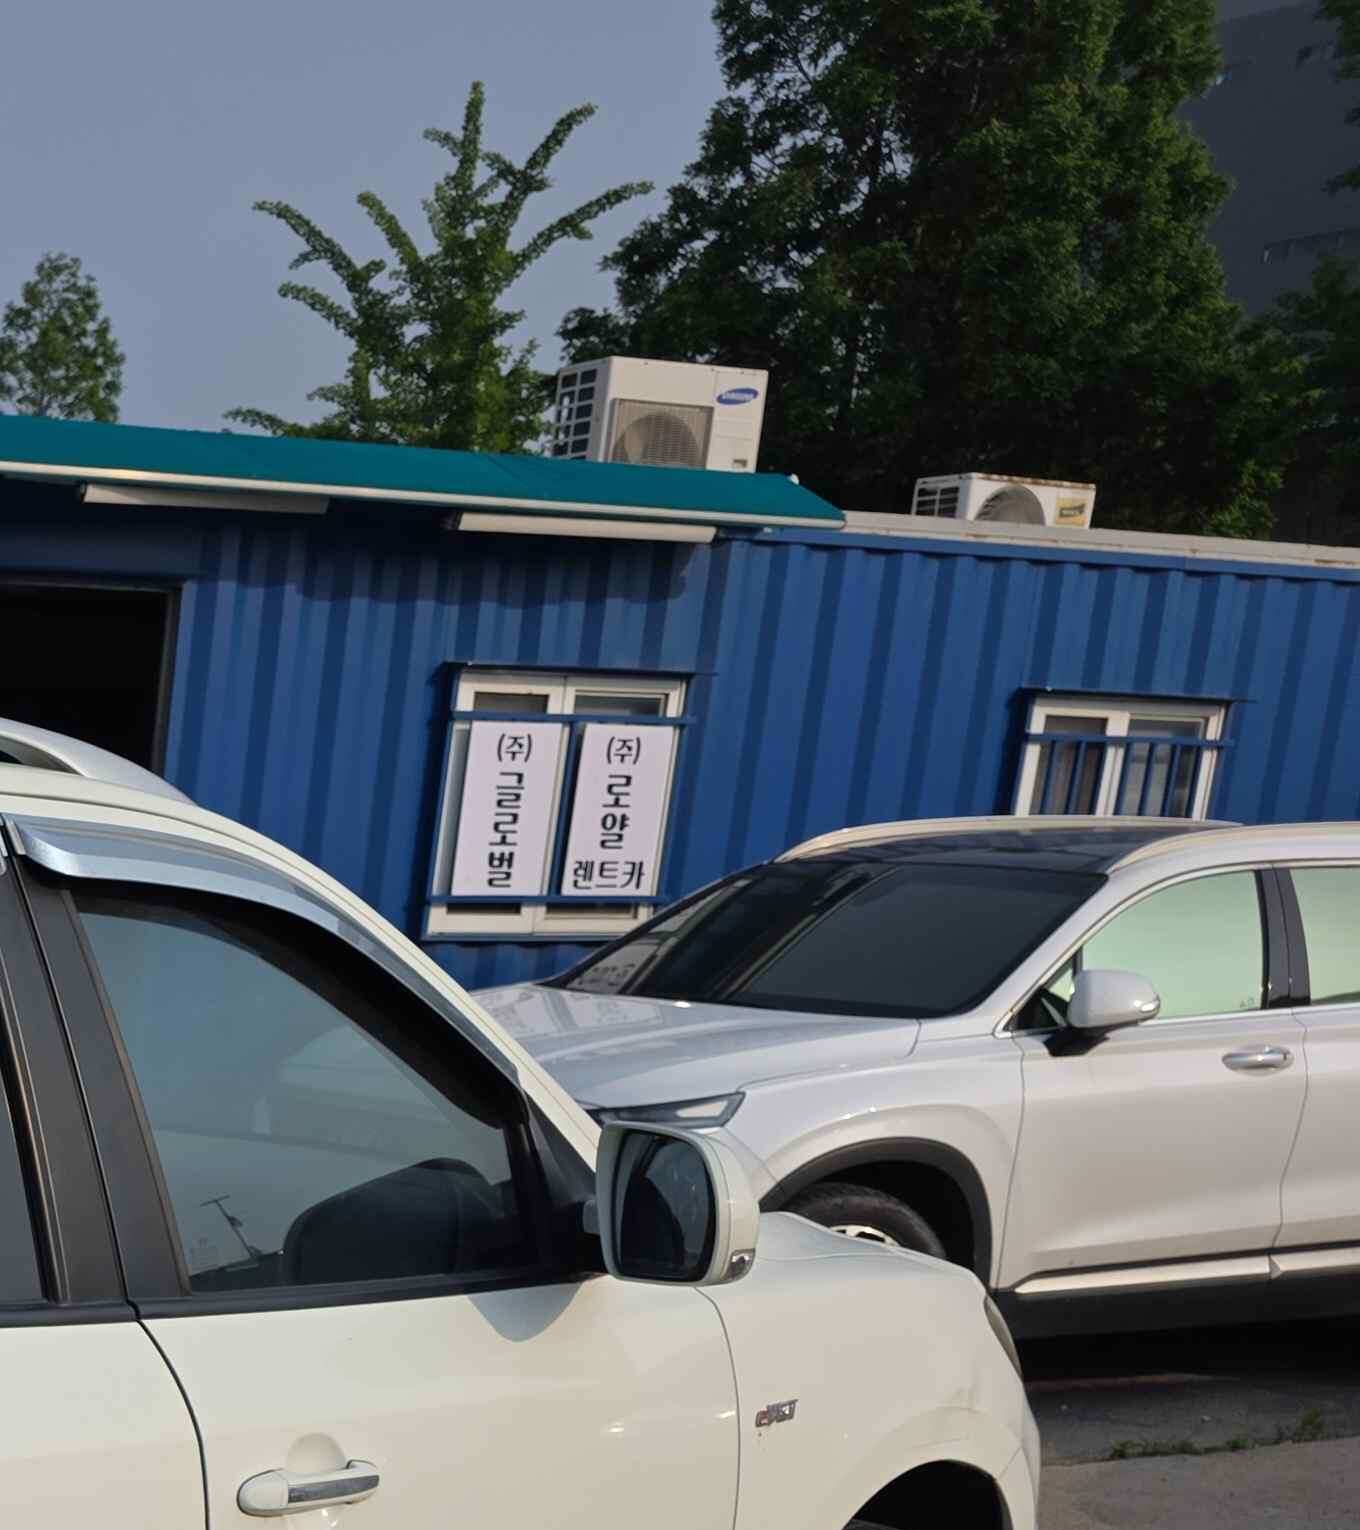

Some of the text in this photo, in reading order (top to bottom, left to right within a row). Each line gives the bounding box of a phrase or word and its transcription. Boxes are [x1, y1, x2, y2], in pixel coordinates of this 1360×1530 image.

[487, 733, 532, 888] (주) 글로벌
[600, 736, 641, 850] (주) 로얄
[572, 859, 646, 890] 렌트카
